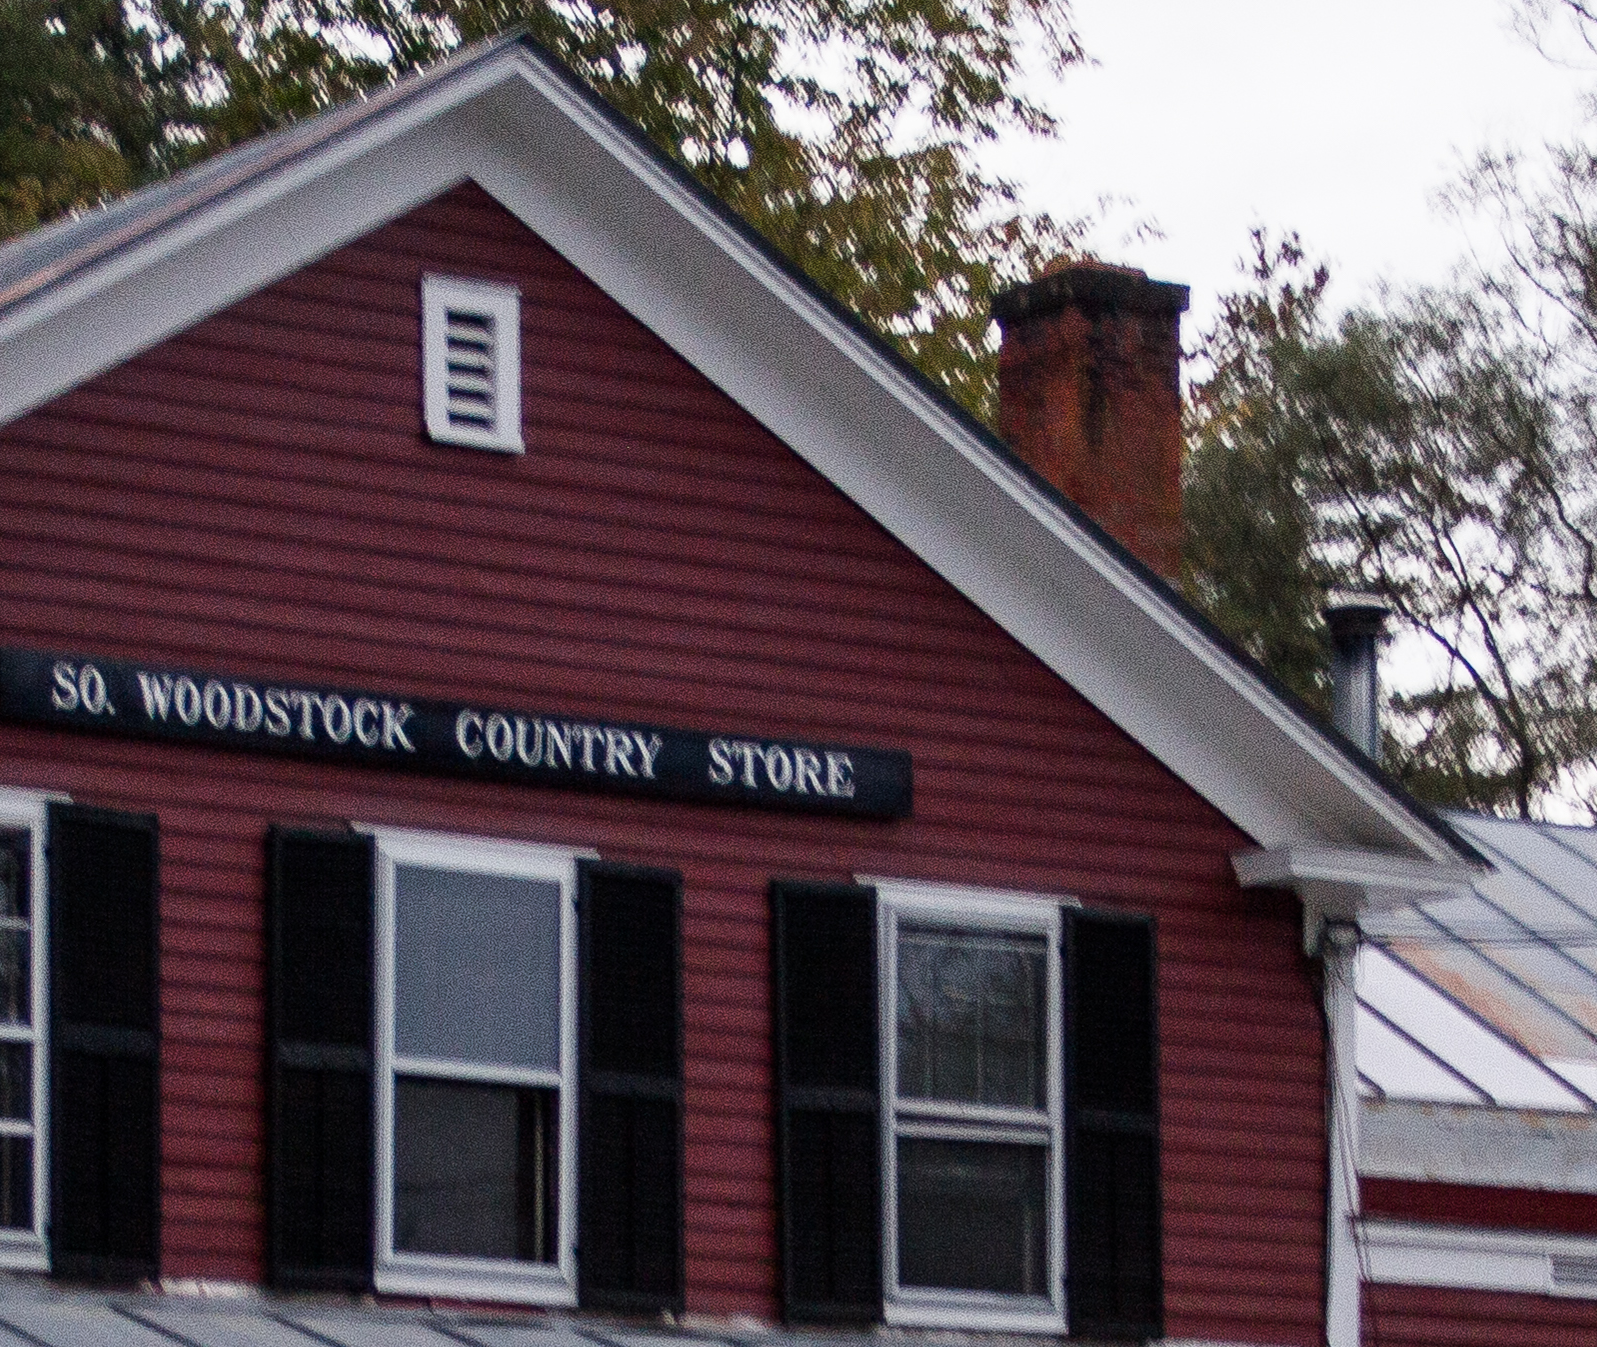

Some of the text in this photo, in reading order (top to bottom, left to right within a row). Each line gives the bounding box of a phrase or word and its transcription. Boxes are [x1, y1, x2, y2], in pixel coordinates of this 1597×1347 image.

[51, 660, 858, 800] SO. WOODSTOCK COUNTRY STORE
